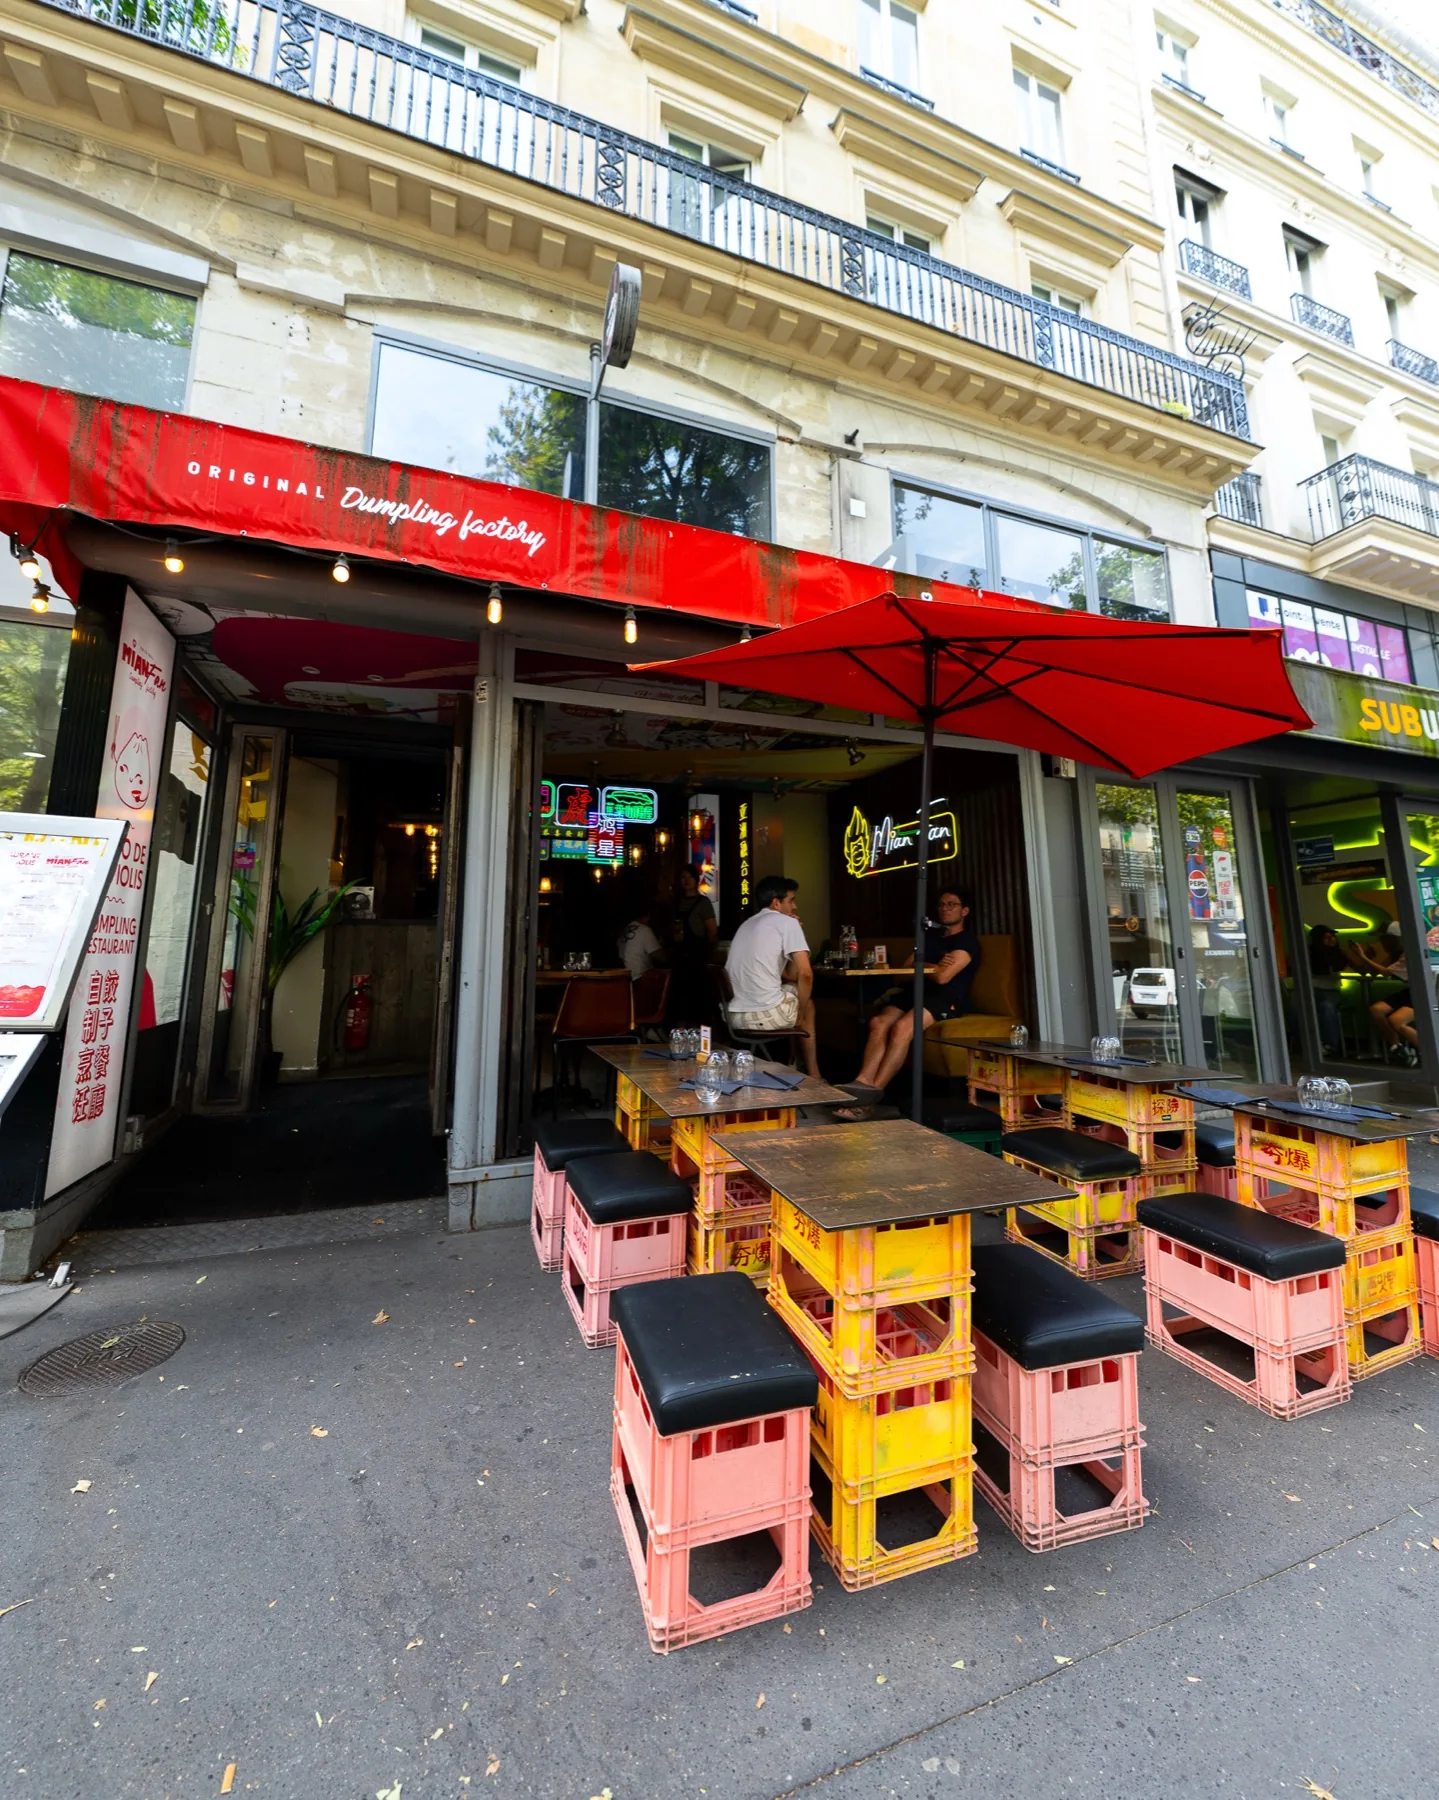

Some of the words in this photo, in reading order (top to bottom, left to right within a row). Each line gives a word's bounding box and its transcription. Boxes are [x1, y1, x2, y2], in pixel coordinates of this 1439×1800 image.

[187, 461, 325, 499] ORIGINAL
[340, 487, 458, 536] Dumpling
[459, 510, 546, 557] factory
[133, 842, 147, 865] DE
[870, 816, 913, 868] Mian
[112, 864, 144, 890] IOLIS
